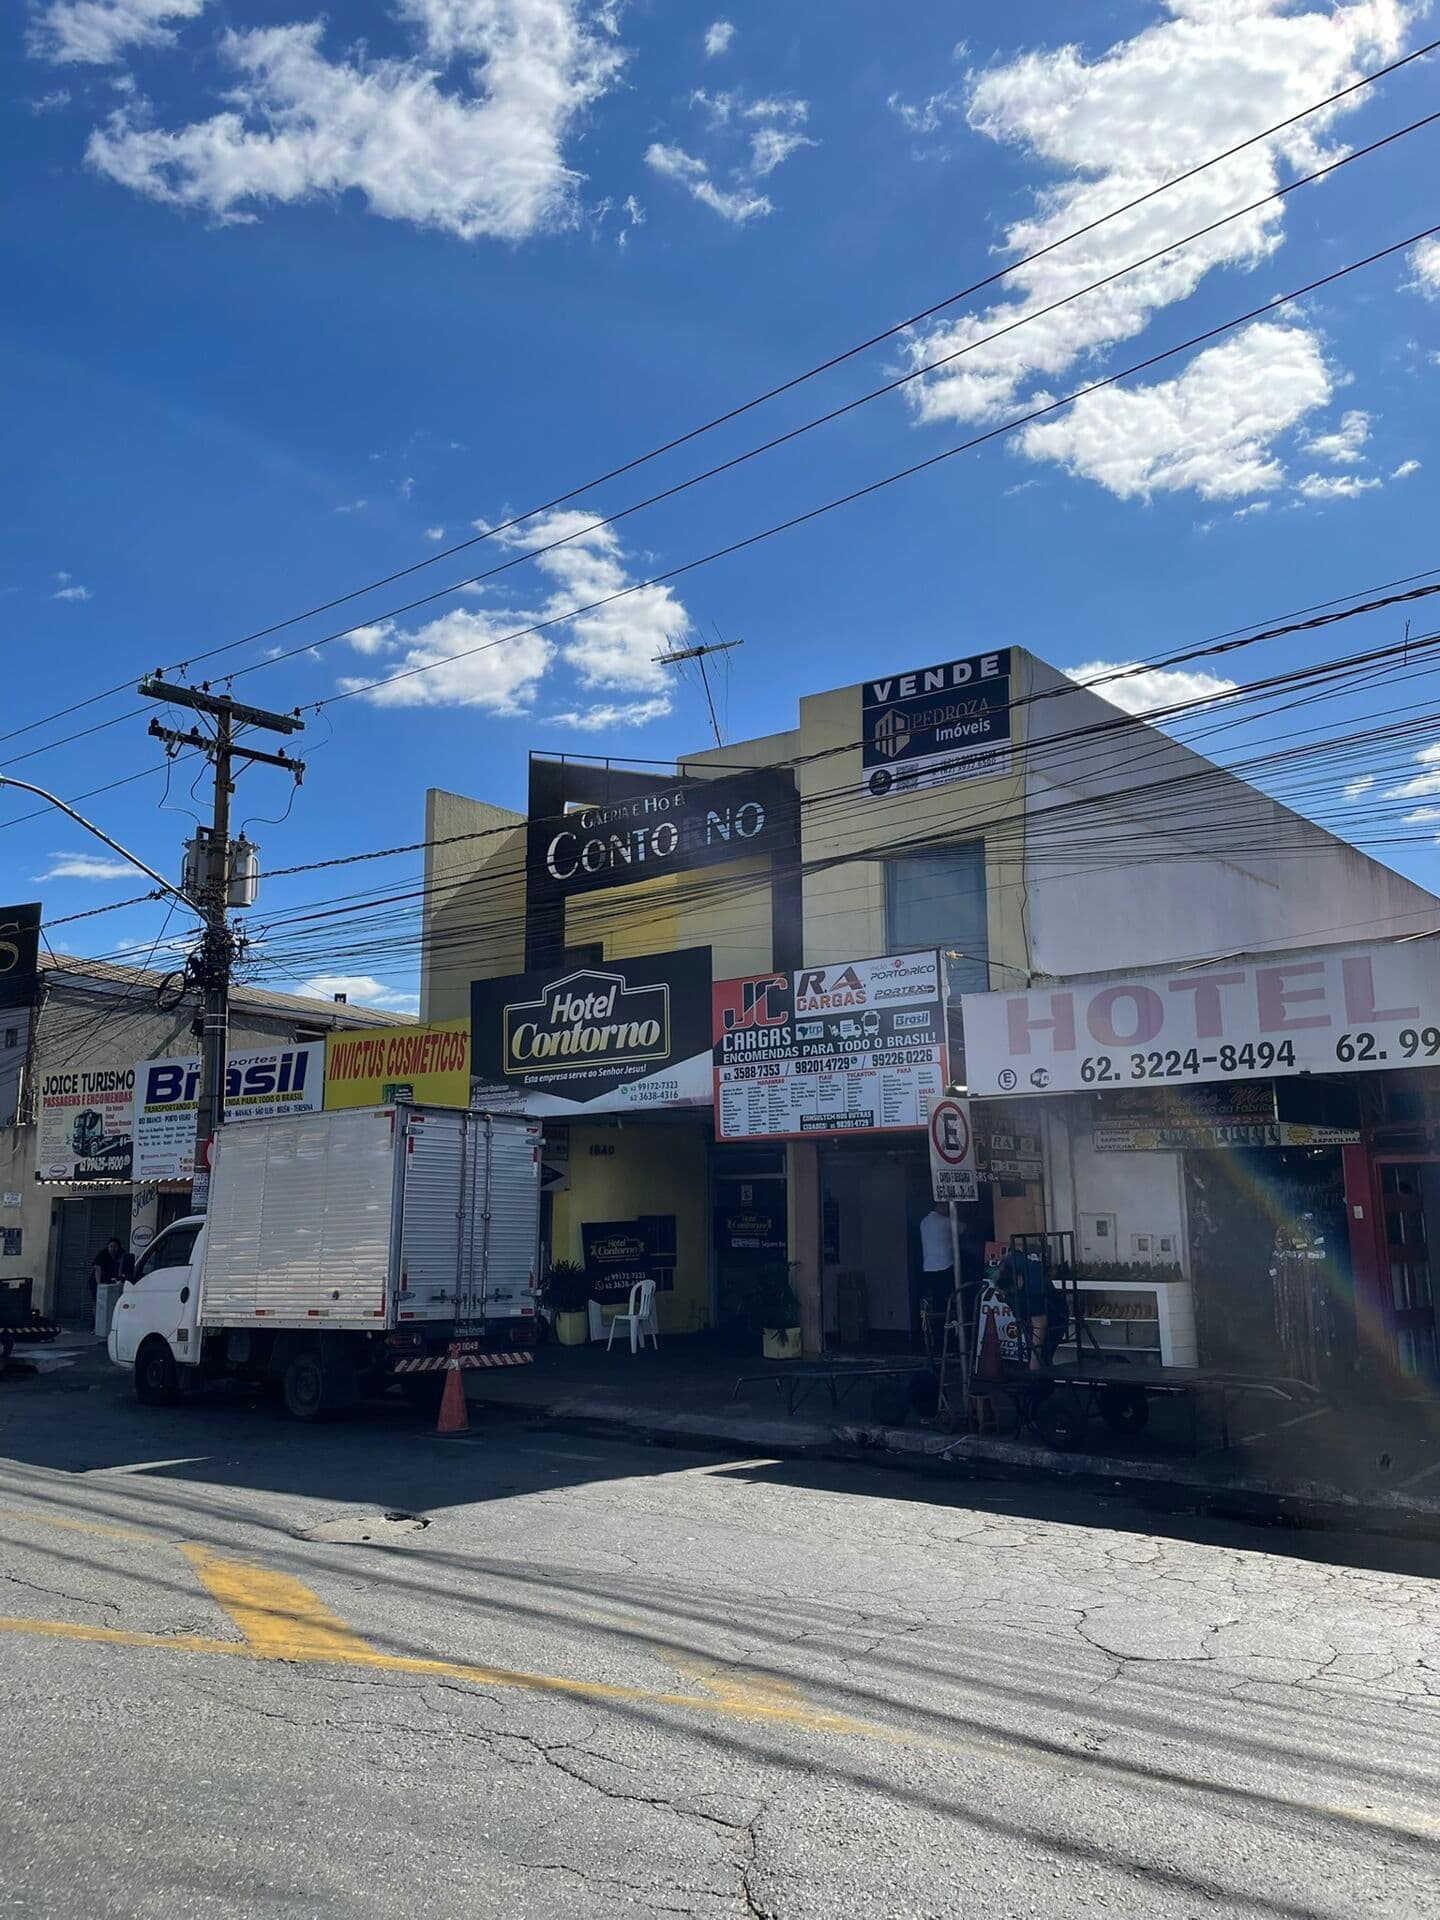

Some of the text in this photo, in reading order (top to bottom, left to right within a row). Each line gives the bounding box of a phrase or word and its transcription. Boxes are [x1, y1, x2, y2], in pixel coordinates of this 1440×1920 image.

[873, 654, 999, 702] VENDE
[911, 697, 990, 730] PEDROZA
[936, 718, 991, 742] Imóveis
[870, 967, 906, 981] PORTO
[722, 977, 789, 1031] JC
[796, 990, 867, 1013] CARGAS
[875, 984, 924, 1000] PORTEX
[550, 985, 617, 1024] Hotel
[1006, 956, 1420, 1056] HOTEL
[896, 1013, 929, 1028] Brasil
[511, 1019, 661, 1060] Contorno
[722, 1026, 791, 1052] CARGAS
[723, 1032, 936, 1064] ENCOMENDAS PARA TODO O BRASIL!
[187, 1056, 277, 1070] Trportes
[329, 1039, 385, 1081] INVICTUS
[734, 1064, 780, 1079] 3588-7353
[796, 1057, 850, 1073] 98201-4729
[872, 1049, 933, 1066] 99226-0226
[1080, 1057, 1121, 1083] 62.
[1130, 1040, 1296, 1080] 3224-8494
[1336, 1032, 1388, 1062] 62.
[42, 1069, 135, 1095] JOICE TURISMO
[524, 1063, 647, 1084] Esta empresa serve ao Senhor Jesus!
[638, 1080, 678, 1091] 99172-7323
[43, 1091, 133, 1108] PASSAGENS E ENCOMENDAS
[144, 1103, 191, 1113] TRANSPORTANDO
[258, 1096, 274, 1104] TODO
[282, 1093, 303, 1102] BRASIL
[639, 1091, 678, 1101] 3638-4316
[165, 1113, 178, 1123] PORTO
[943, 1113, 960, 1150] E
[598, 1246, 638, 1256] Contorno
[607, 1238, 626, 1247] Hotel
